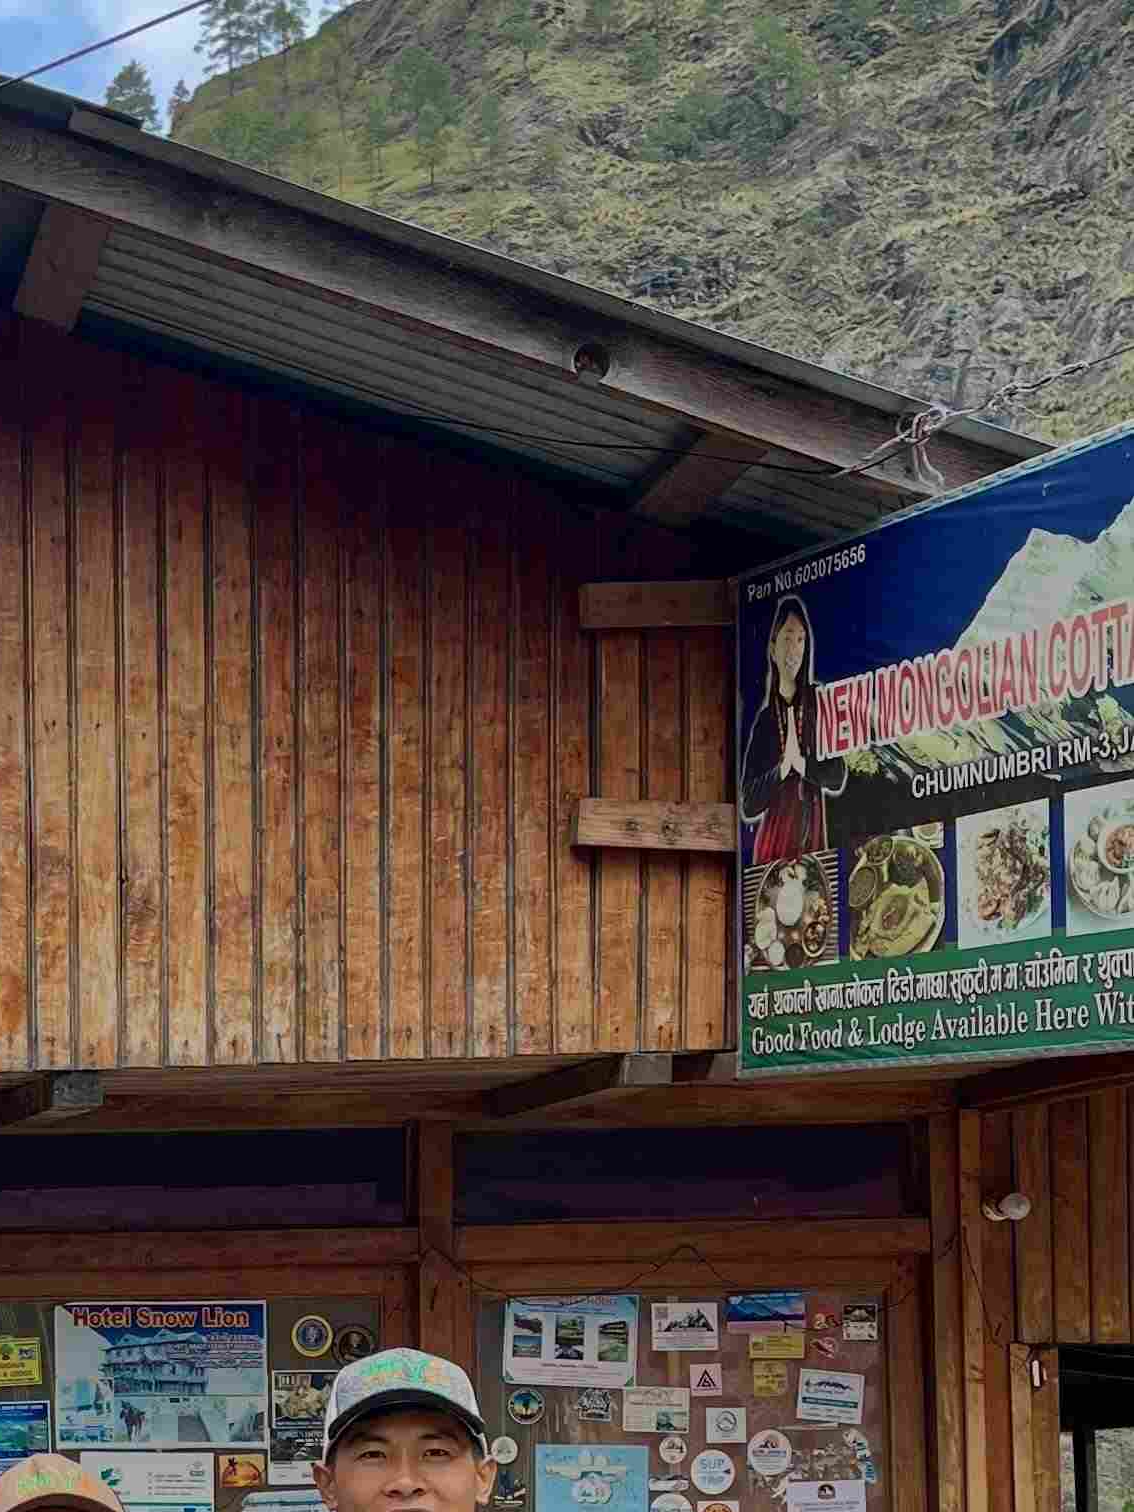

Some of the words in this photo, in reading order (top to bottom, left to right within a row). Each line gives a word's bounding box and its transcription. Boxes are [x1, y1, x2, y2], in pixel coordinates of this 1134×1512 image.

[747, 583, 772, 603] Pan
[816, 672, 871, 754] NEW
[873, 630, 1039, 742] MONGOLIAN
[912, 748, 1053, 799] CHUMNUMBRI
[1058, 726, 1134, 770] RM-3,J
[751, 1023, 794, 1056] Good
[799, 1018, 843, 1052] Food
[848, 1016, 864, 1047] &
[867, 1012, 926, 1049] Lodge
[930, 1002, 1029, 1041] Available
[1034, 998, 1090, 1032] Here
[72, 1306, 133, 1329] Hotel
[136, 1306, 198, 1328] Snow
[201, 1306, 251, 1328] Lion
